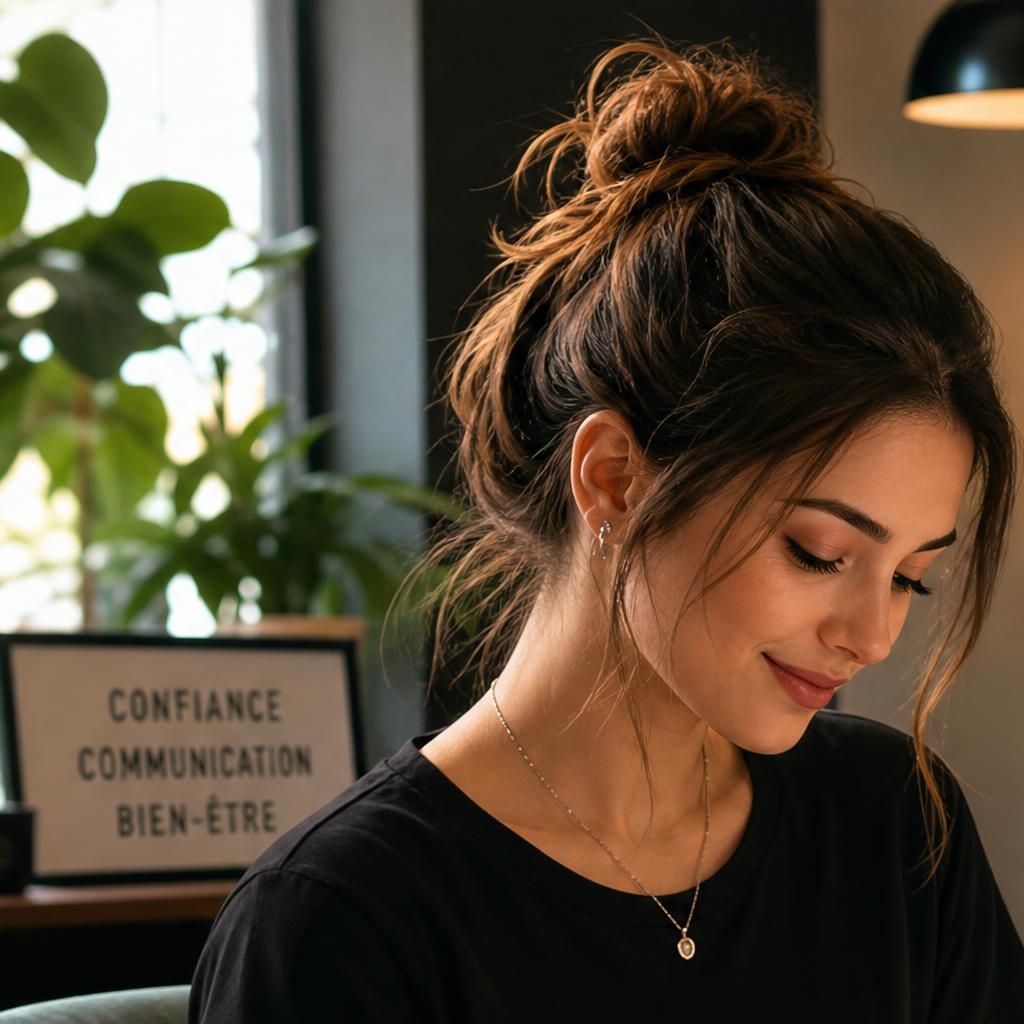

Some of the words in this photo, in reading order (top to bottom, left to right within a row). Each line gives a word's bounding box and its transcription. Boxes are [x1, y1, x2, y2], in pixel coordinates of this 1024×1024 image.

[108, 687, 281, 724] CONFIANCE
[77, 744, 313, 782] COMMUNICATION
[116, 793, 277, 839] BIEN-ÊTRE
